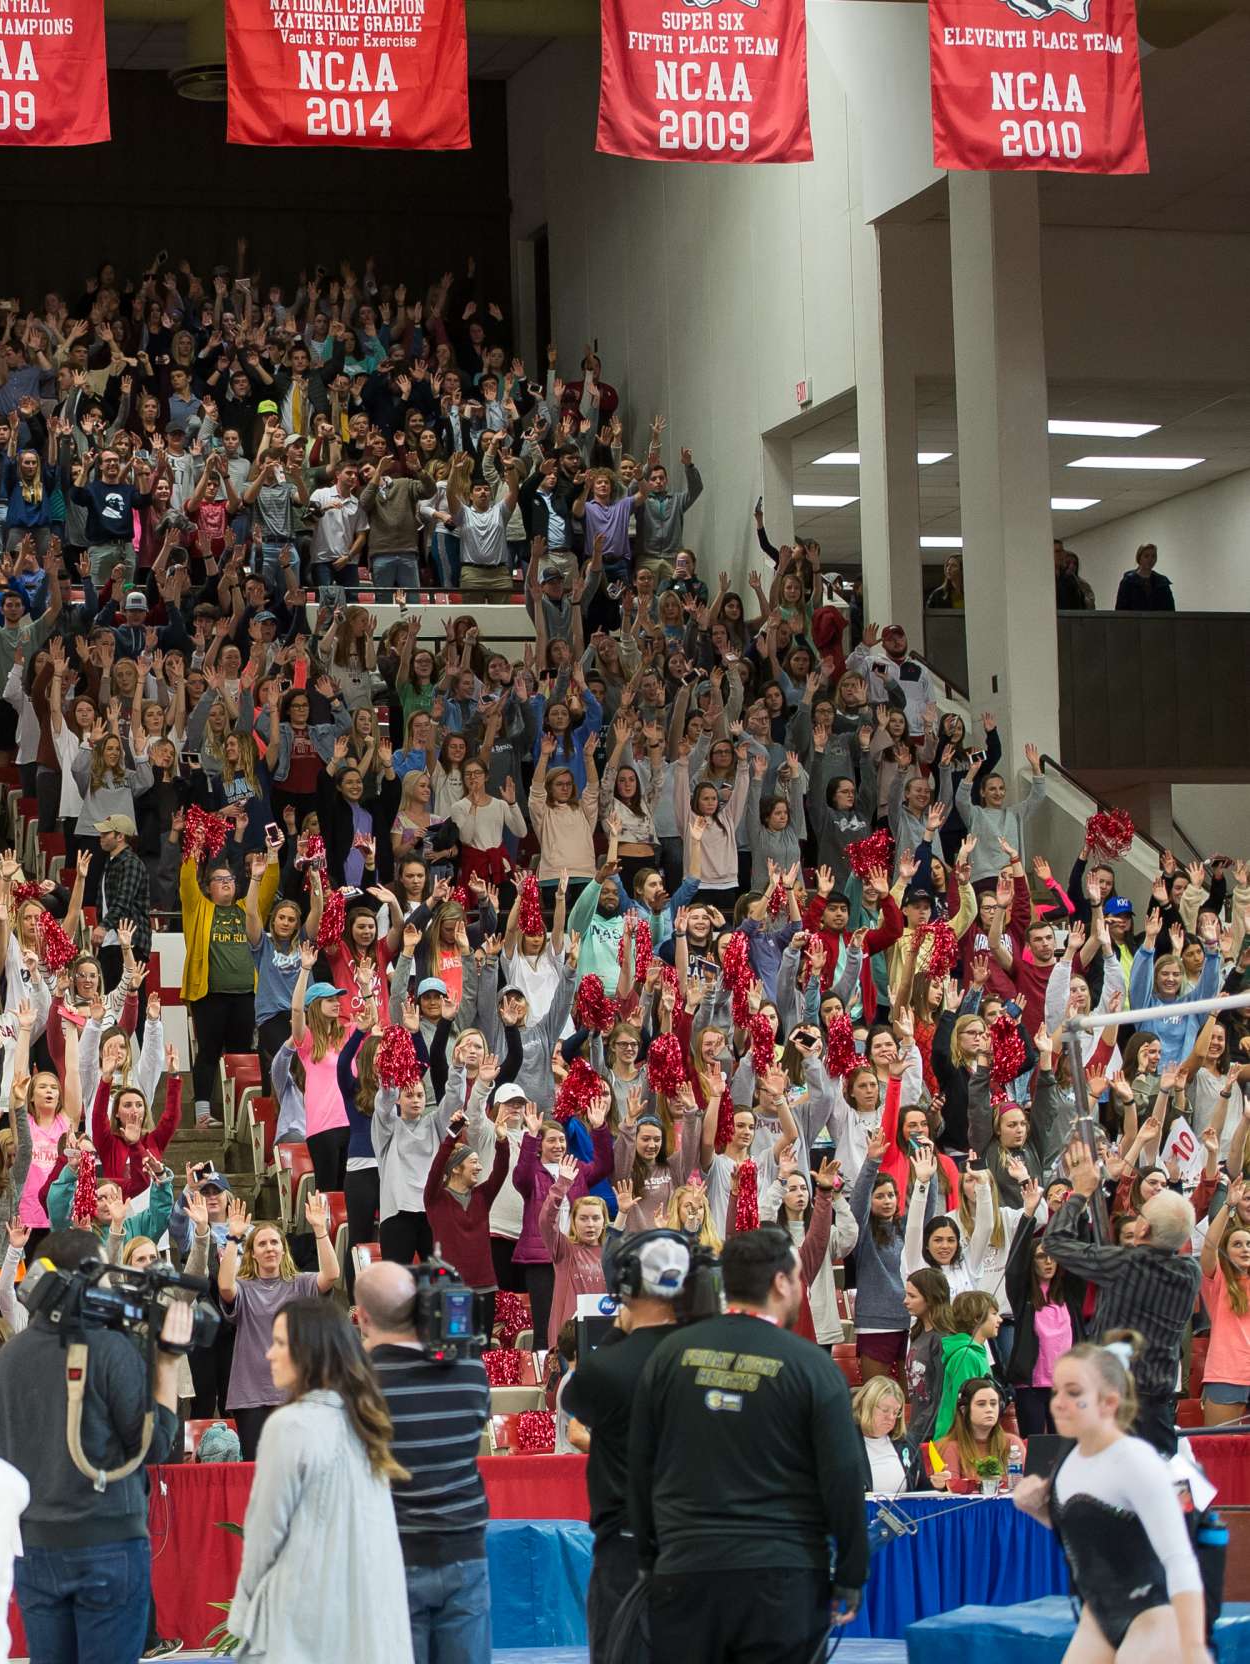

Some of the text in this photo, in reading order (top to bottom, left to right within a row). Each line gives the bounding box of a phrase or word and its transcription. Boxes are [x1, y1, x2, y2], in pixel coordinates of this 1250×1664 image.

[269, 0, 426, 15] NATIONAL CHAMPION
[273, 11, 423, 33] KATHERINE GRABLE
[661, 11, 745, 32] SUPER SIX
[280, 29, 417, 48] Vault & Floor Exercise
[628, 31, 779, 57] FIFTH PLACE TEAM
[943, 27, 1124, 54] ELEVENTH PLACE TEAM
[298, 49, 399, 92] NCAA
[655, 60, 753, 102] NCAA
[990, 71, 1087, 113] NCAA
[306, 96, 392, 138] 2014
[659, 109, 750, 152] 2009
[1000, 119, 1083, 159] 2010
[212, 932, 231, 943] FUN
[1171, 1131, 1196, 1162] 10
